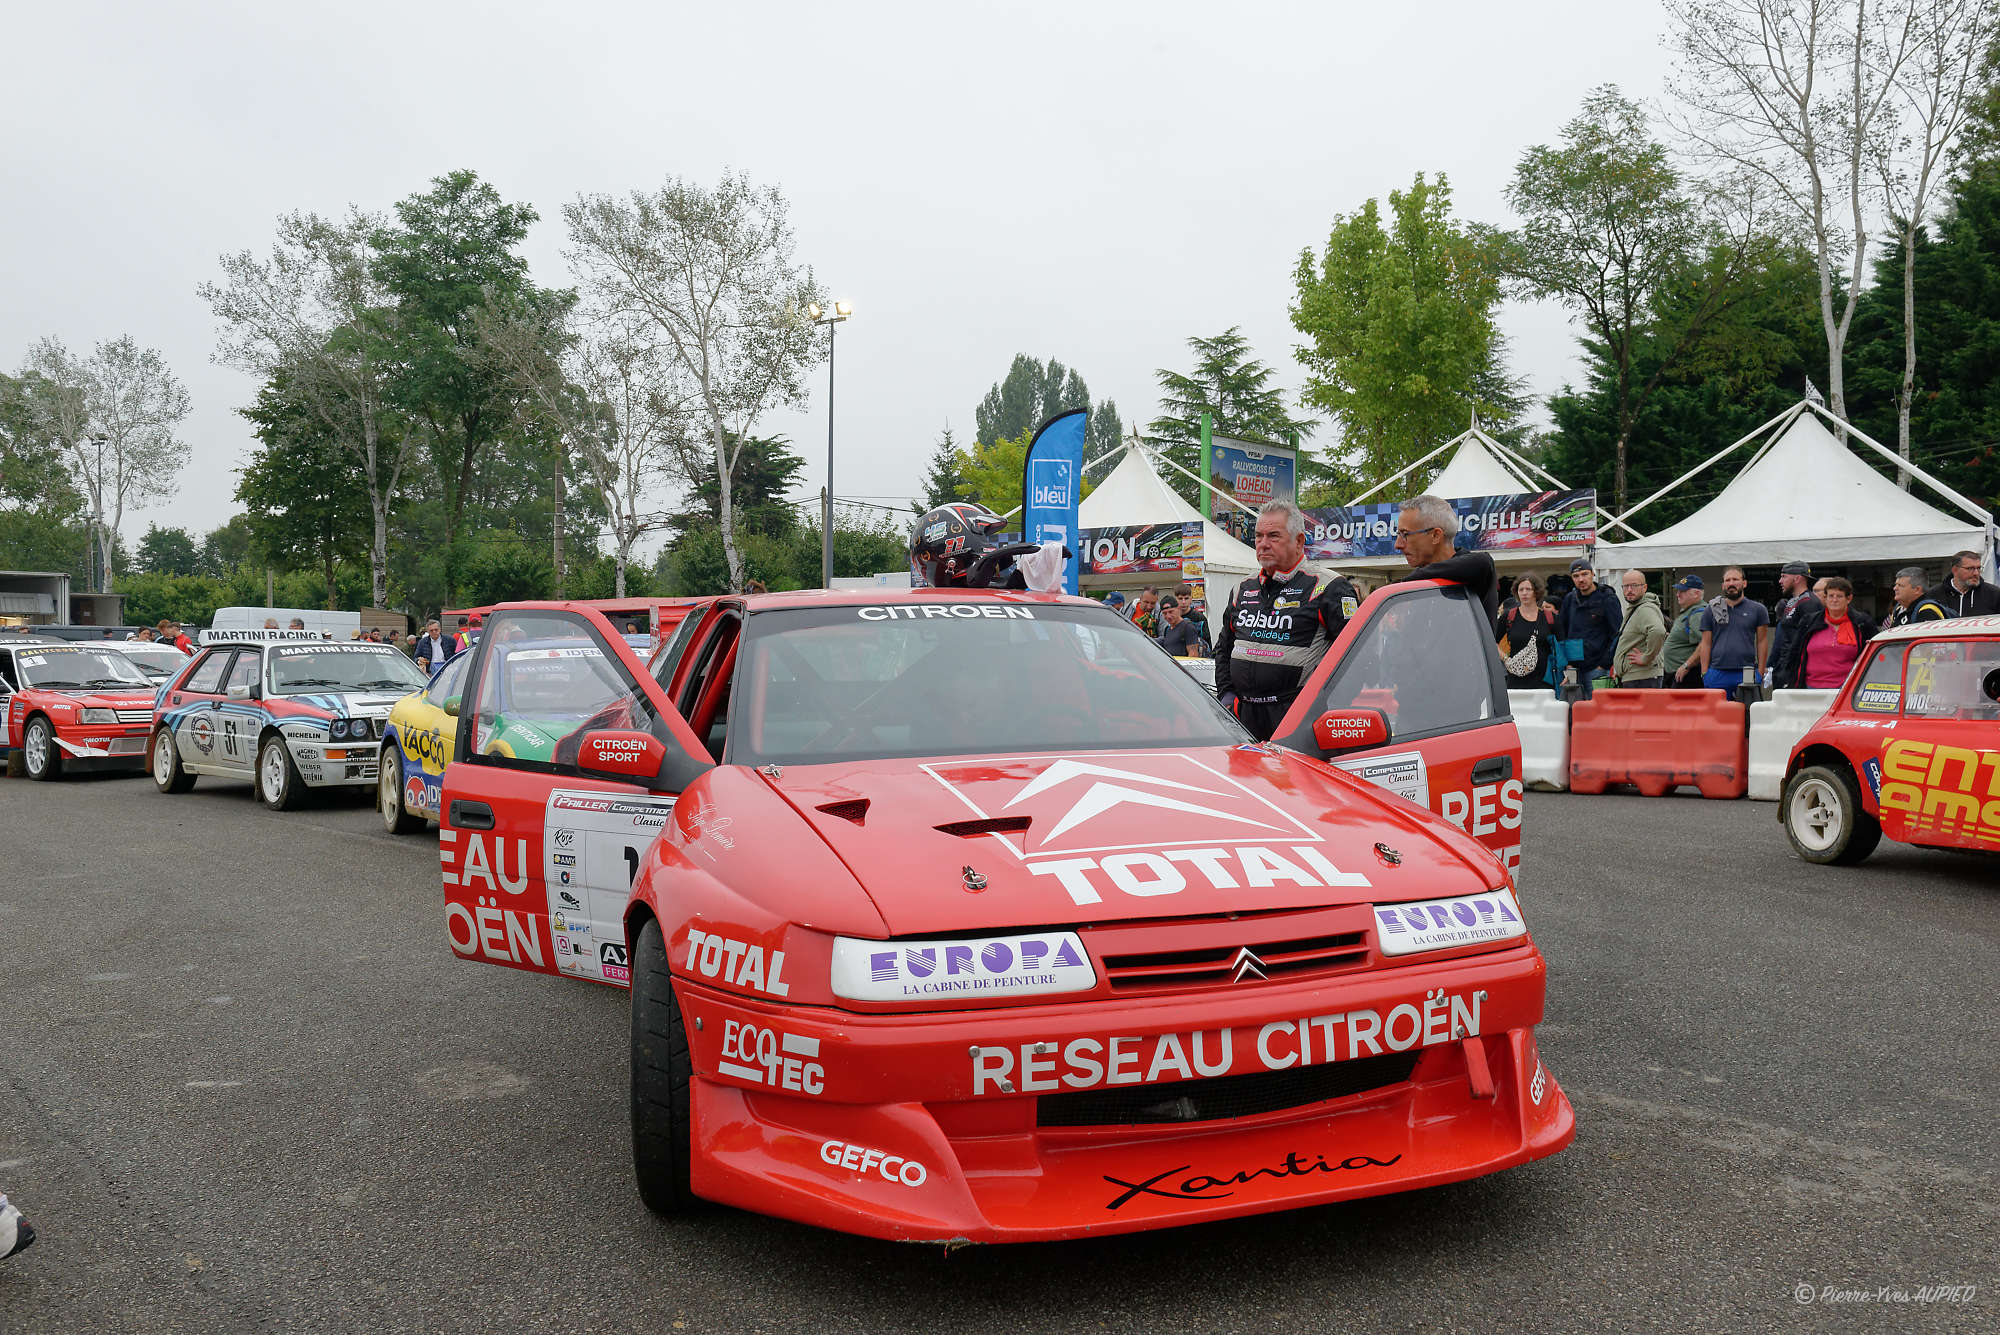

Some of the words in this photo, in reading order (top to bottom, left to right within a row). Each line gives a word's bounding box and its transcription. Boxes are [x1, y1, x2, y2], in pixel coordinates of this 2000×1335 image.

[1232, 460, 1268, 474] RALLYCROSS
[1268, 466, 1276, 475] DE
[1236, 474, 1272, 494] LOHÉAC
[1035, 485, 1066, 504] bleu
[1313, 519, 1400, 541] BOUTIQU
[1457, 510, 1532, 532] ICIELLE
[858, 604, 1036, 621] CITROEN
[1236, 609, 1293, 630] Salaün
[208, 631, 266, 641] MARTINI
[269, 631, 318, 640] RACING
[279, 646, 342, 656] MARTINI
[343, 646, 394, 655] RACING
[1862, 690, 1900, 703] OWENS
[1326, 717, 1371, 728] CITROËN
[287, 731, 321, 739] MICHELIN
[1331, 729, 1366, 739] SPORT
[403, 720, 445, 770] YACCO
[592, 738, 648, 751] CITROËN
[598, 751, 641, 763] SPORT
[1388, 773, 1415, 785] Classic
[632, 814, 666, 827] Classic
[554, 828, 574, 848] Rose
[1026, 846, 1373, 906] TOTAL
[1376, 897, 1518, 935] EUROPA
[1413, 935, 1425, 945] LA
[1426, 931, 1458, 944] CABINE
[1459, 930, 1470, 940] DE
[1471, 926, 1509, 939] PEINTURE
[685, 928, 789, 997] TOTAL
[870, 937, 1085, 982] EUROPA
[903, 984, 920, 995] LA
[923, 979, 971, 993] CABINE
[974, 977, 991, 989] DE
[994, 974, 1057, 988] PEINTURE
[973, 1027, 1233, 1096] RESEAU
[1257, 988, 1482, 1070] CITROËN
[820, 1140, 927, 1187] GEFCO
[1103, 1152, 1402, 1210] Xantia
